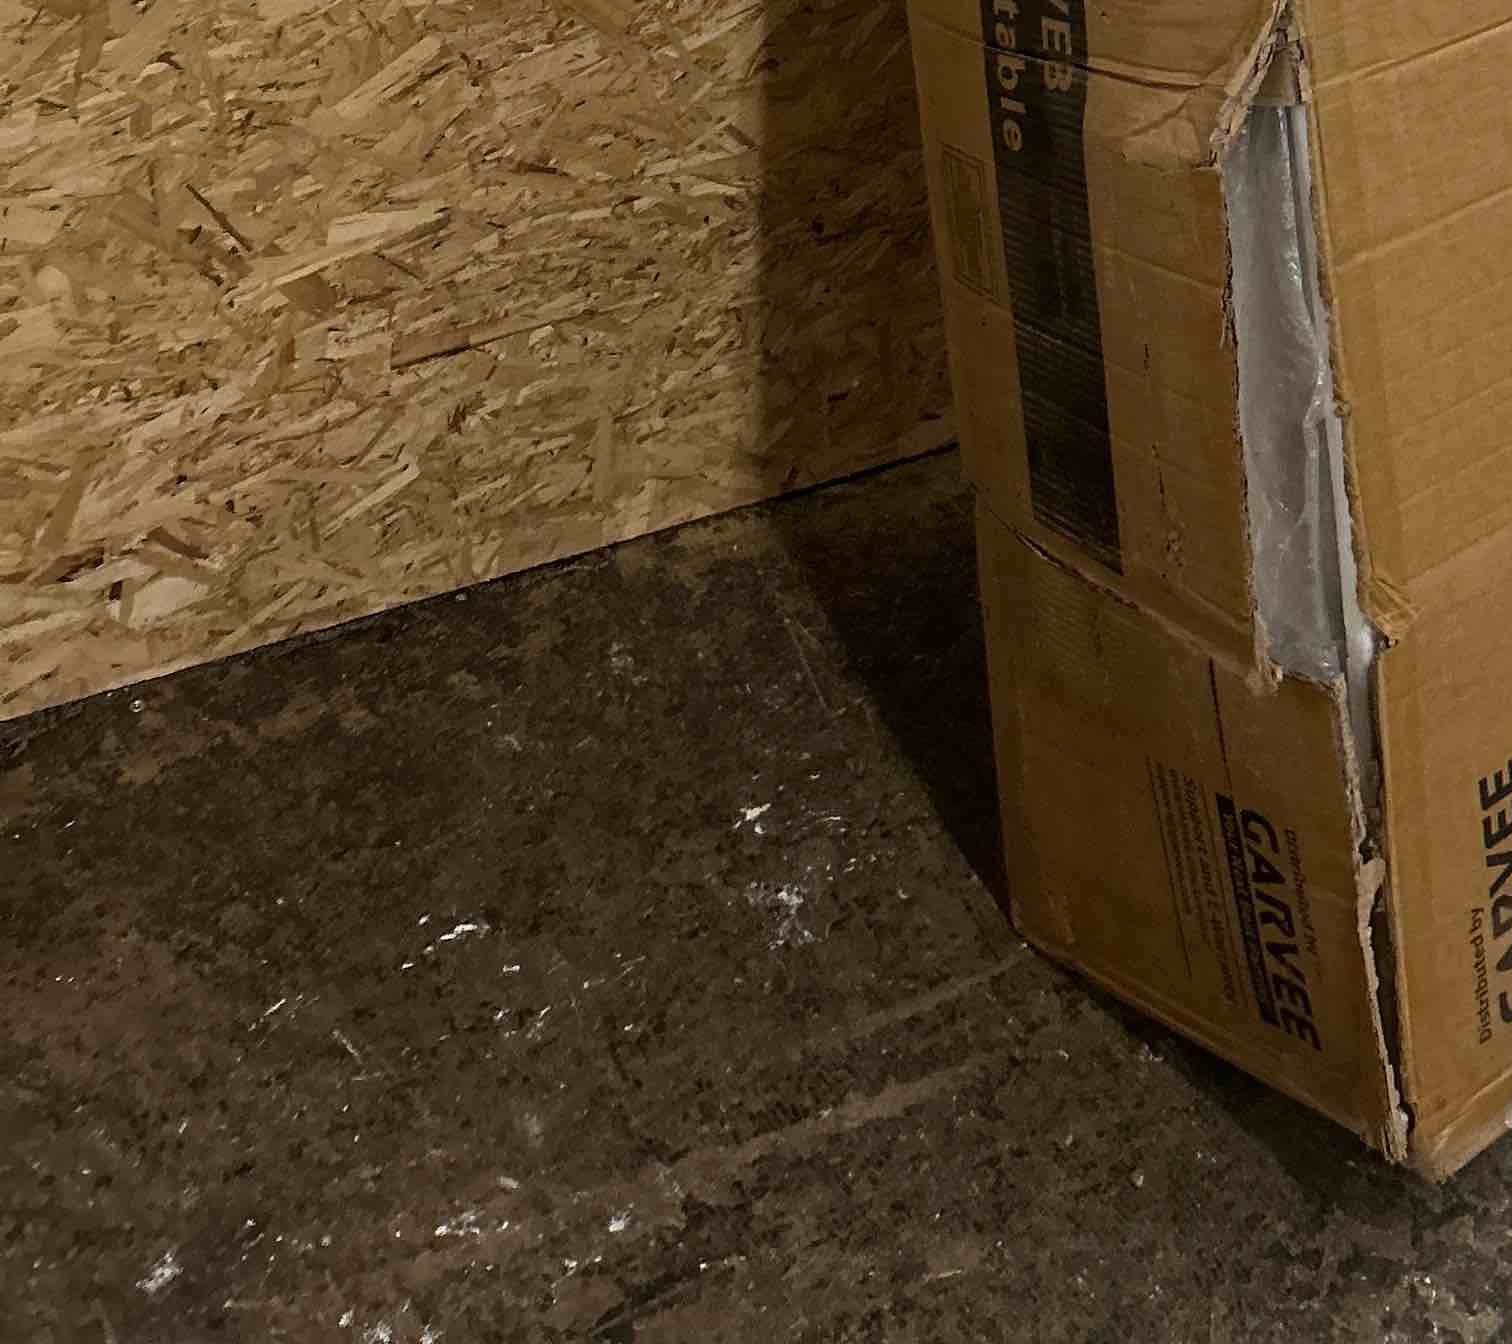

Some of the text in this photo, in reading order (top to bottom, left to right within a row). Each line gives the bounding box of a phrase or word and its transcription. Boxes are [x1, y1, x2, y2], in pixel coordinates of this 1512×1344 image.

[1241, 807, 1322, 1052] GARVEE
[1470, 907, 1493, 1045] Distributed by
